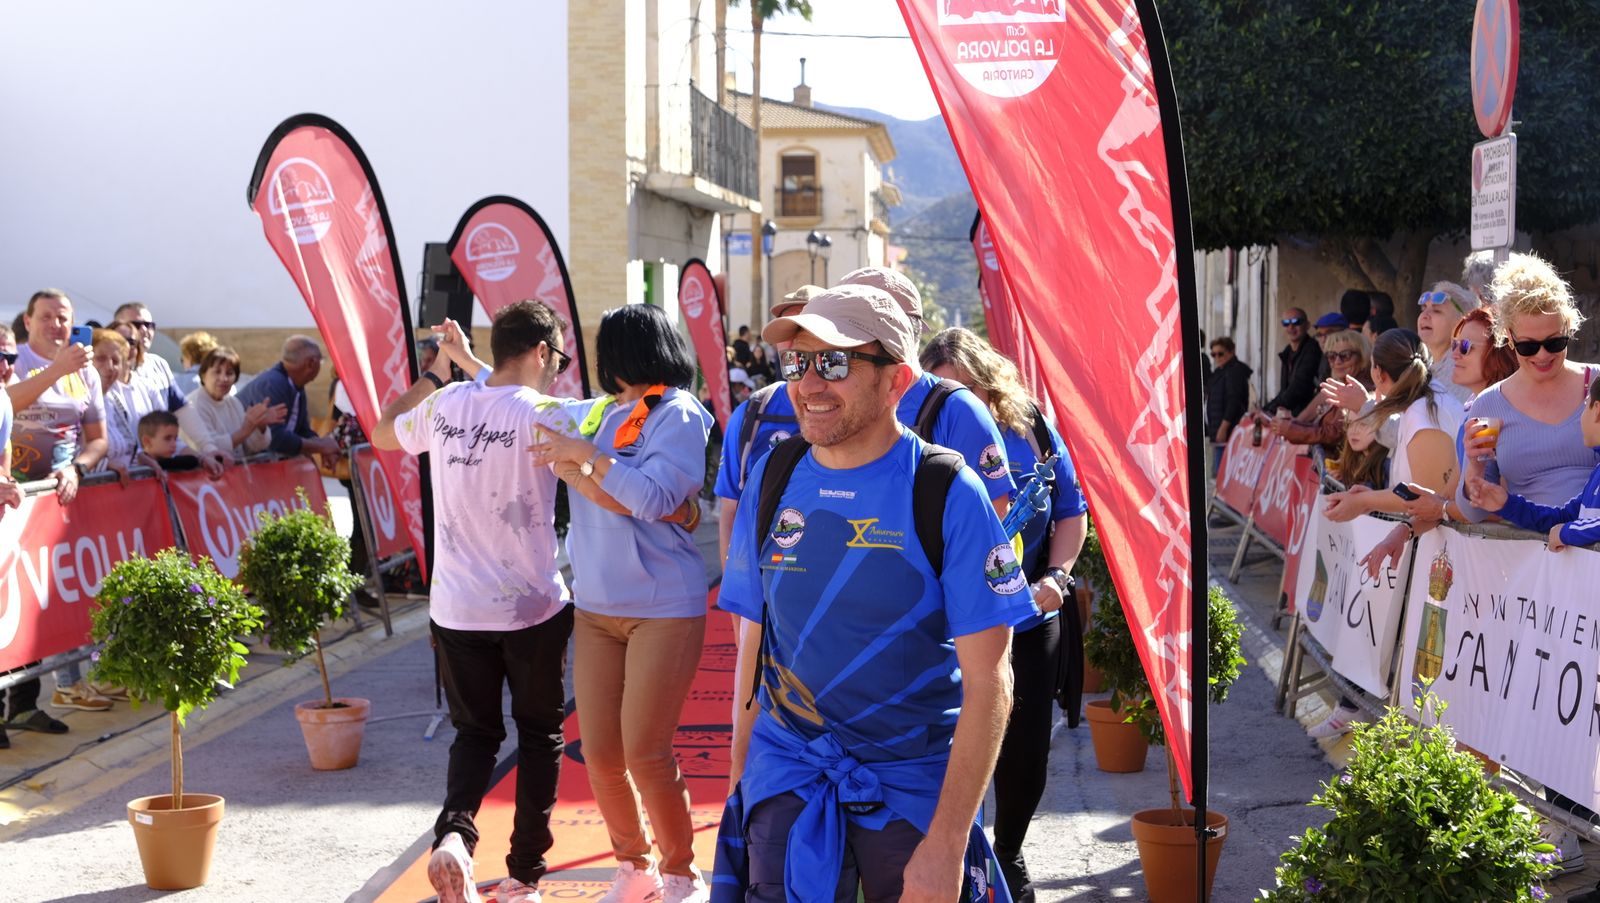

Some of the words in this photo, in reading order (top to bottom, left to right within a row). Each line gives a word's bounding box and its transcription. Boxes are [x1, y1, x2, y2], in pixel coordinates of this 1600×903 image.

[1483, 142, 1510, 161] PROHIBIDO
[1495, 188, 1509, 203] PLAZA
[433, 412, 466, 447] Pepe
[446, 453, 483, 468] speaker
